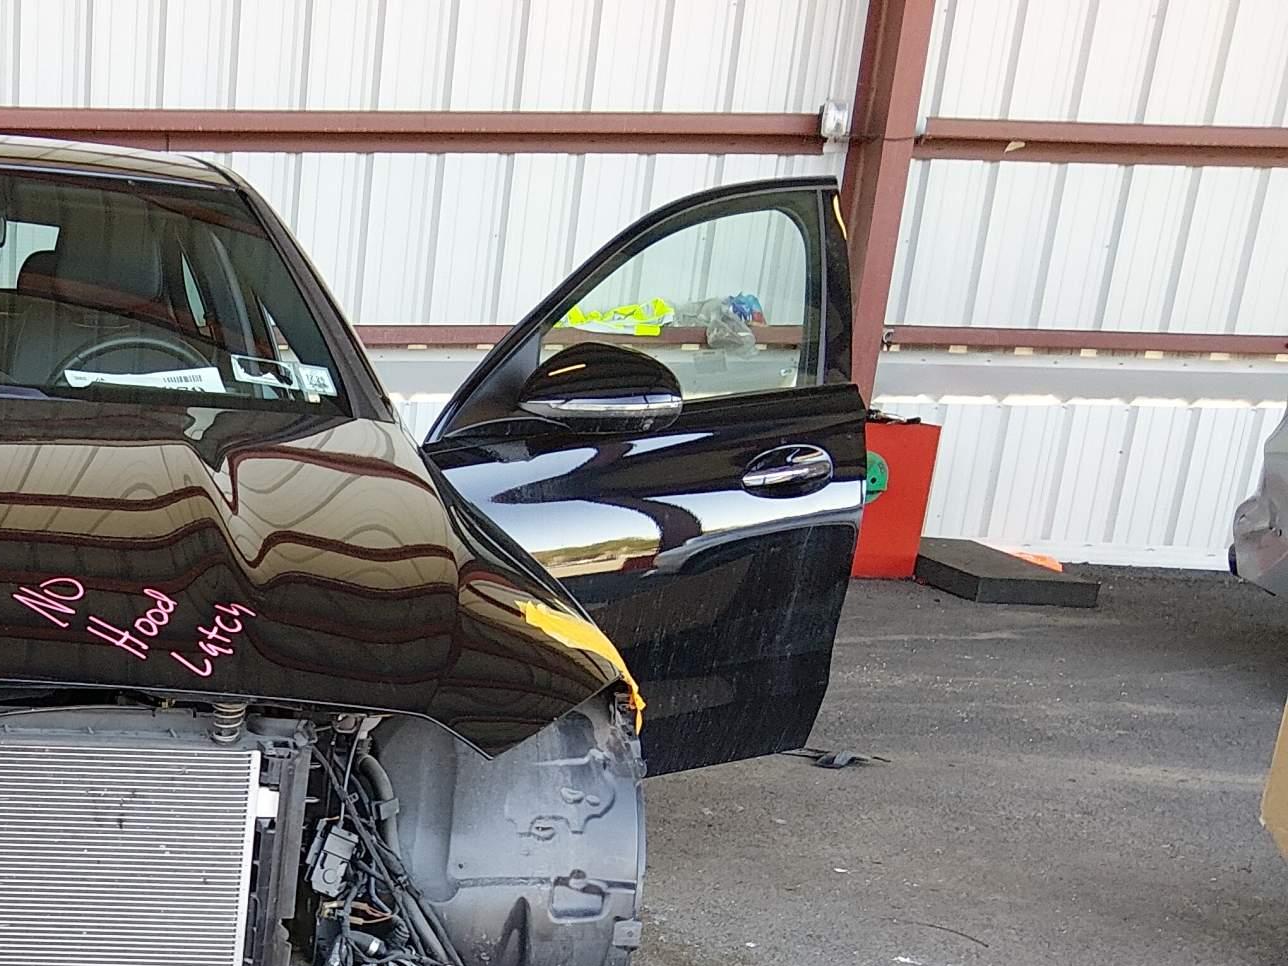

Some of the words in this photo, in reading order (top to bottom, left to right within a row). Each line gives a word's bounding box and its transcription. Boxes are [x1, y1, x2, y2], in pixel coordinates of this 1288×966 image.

[13, 577, 85, 628] NO
[86, 588, 178, 659] Hood
[170, 603, 257, 677] Latch
